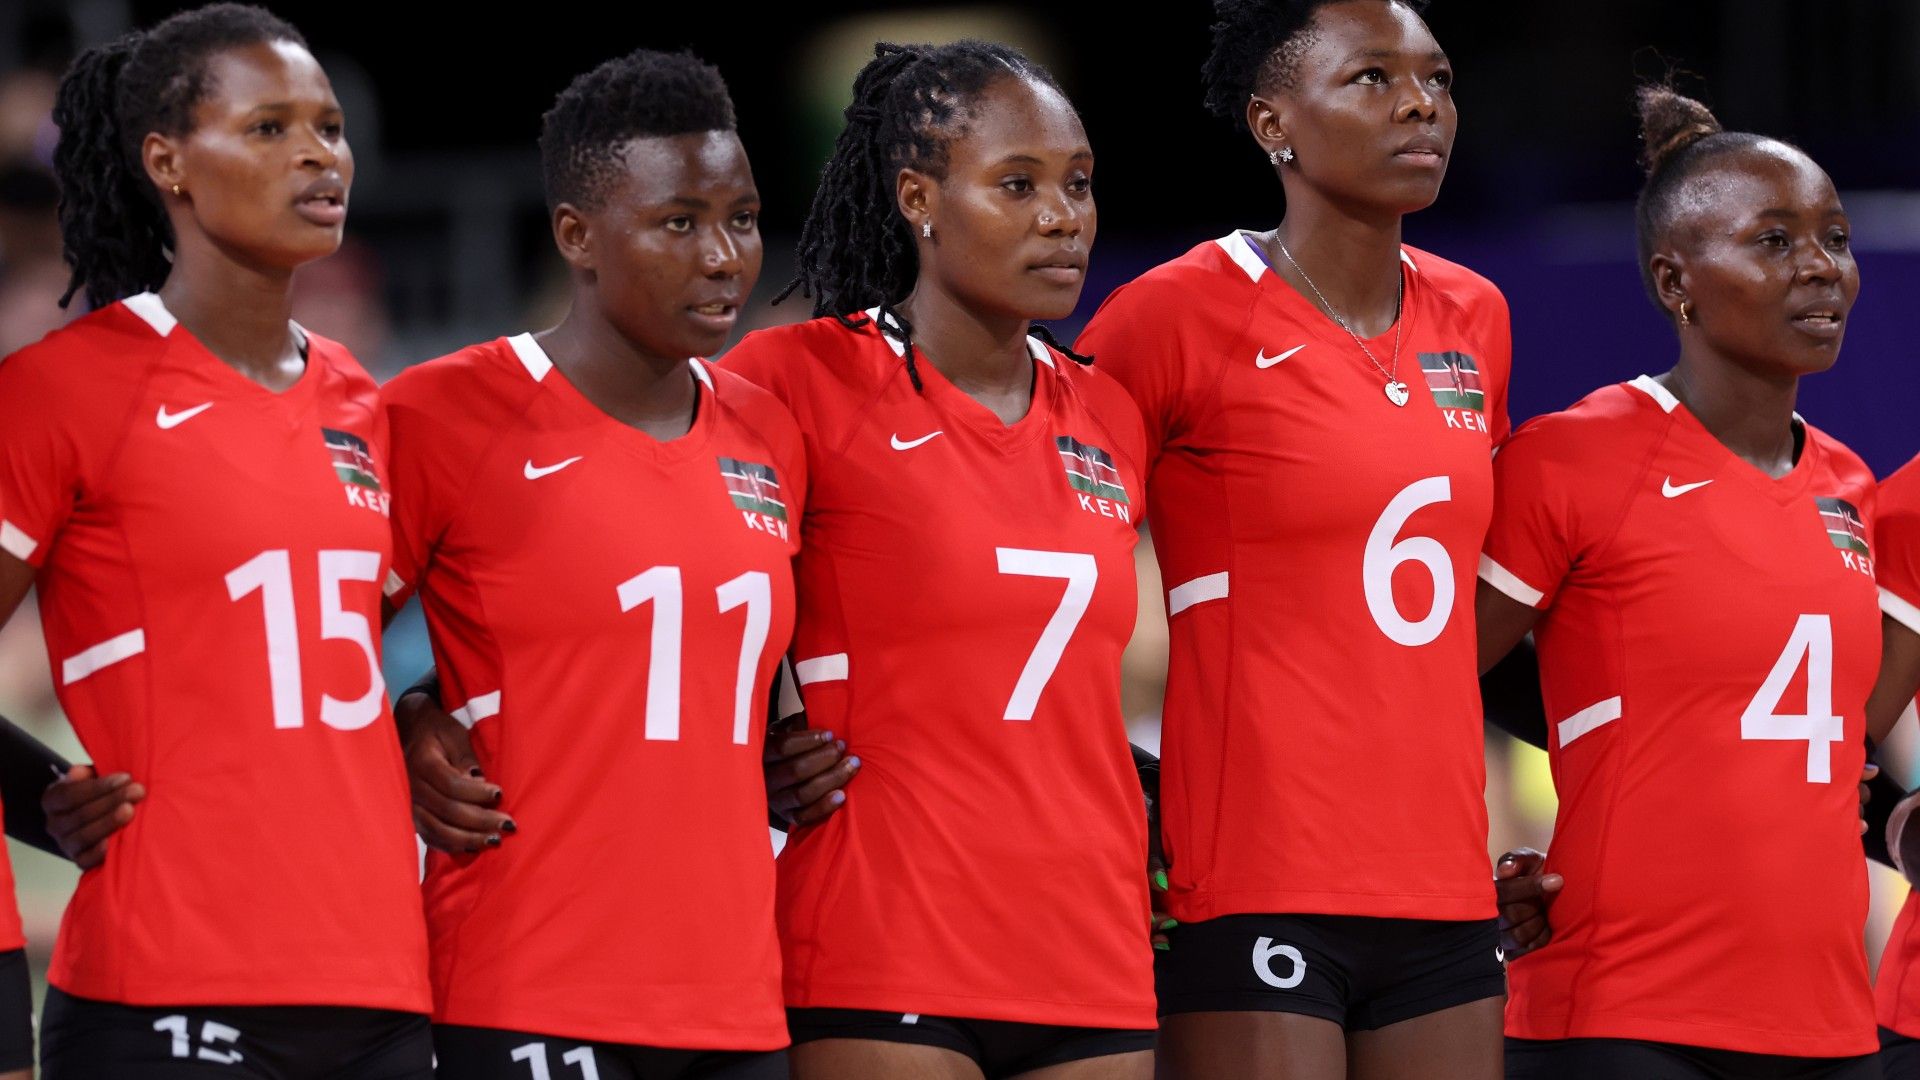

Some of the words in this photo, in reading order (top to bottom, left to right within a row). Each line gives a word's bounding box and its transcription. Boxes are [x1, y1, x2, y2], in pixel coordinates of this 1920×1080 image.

[1442, 409, 1488, 434] KEN
[741, 511, 789, 544] KEN
[1077, 492, 1131, 524] KEN
[1362, 475, 1455, 647] 6
[225, 549, 386, 731] 15
[616, 565, 773, 745] 11
[995, 546, 1099, 721] 7
[1740, 613, 1844, 784] 4
[1252, 936, 1307, 989] 6
